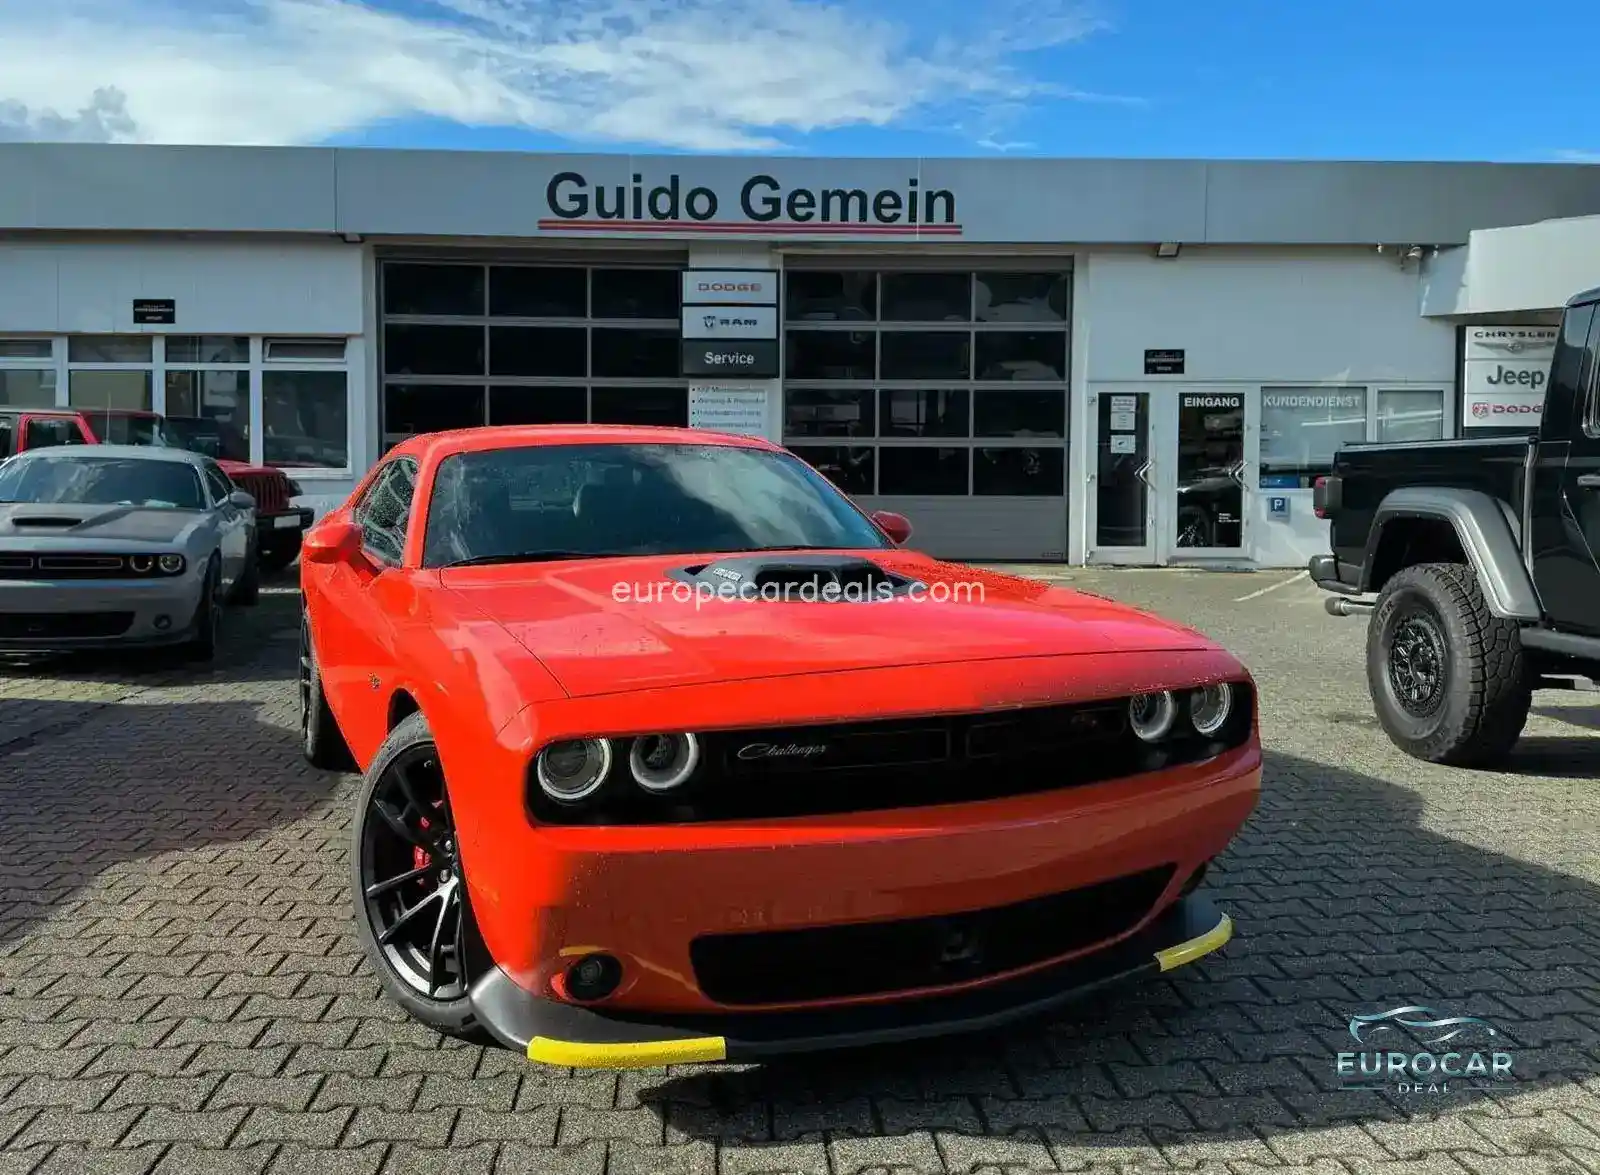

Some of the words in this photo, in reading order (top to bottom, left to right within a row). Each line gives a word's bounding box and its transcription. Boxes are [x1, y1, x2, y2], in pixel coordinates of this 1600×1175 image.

[546, 171, 718, 221] Guido
[740, 174, 955, 223] Gemein
[698, 282, 763, 292] DODGE
[703, 351, 755, 364] Service
[1486, 365, 1545, 389] Jeep
[1184, 397, 1240, 407] EINGANG
[1263, 395, 1361, 407] KUNDENDIENST
[1492, 405, 1543, 413] DODG
[737, 743, 827, 760] Challenger
